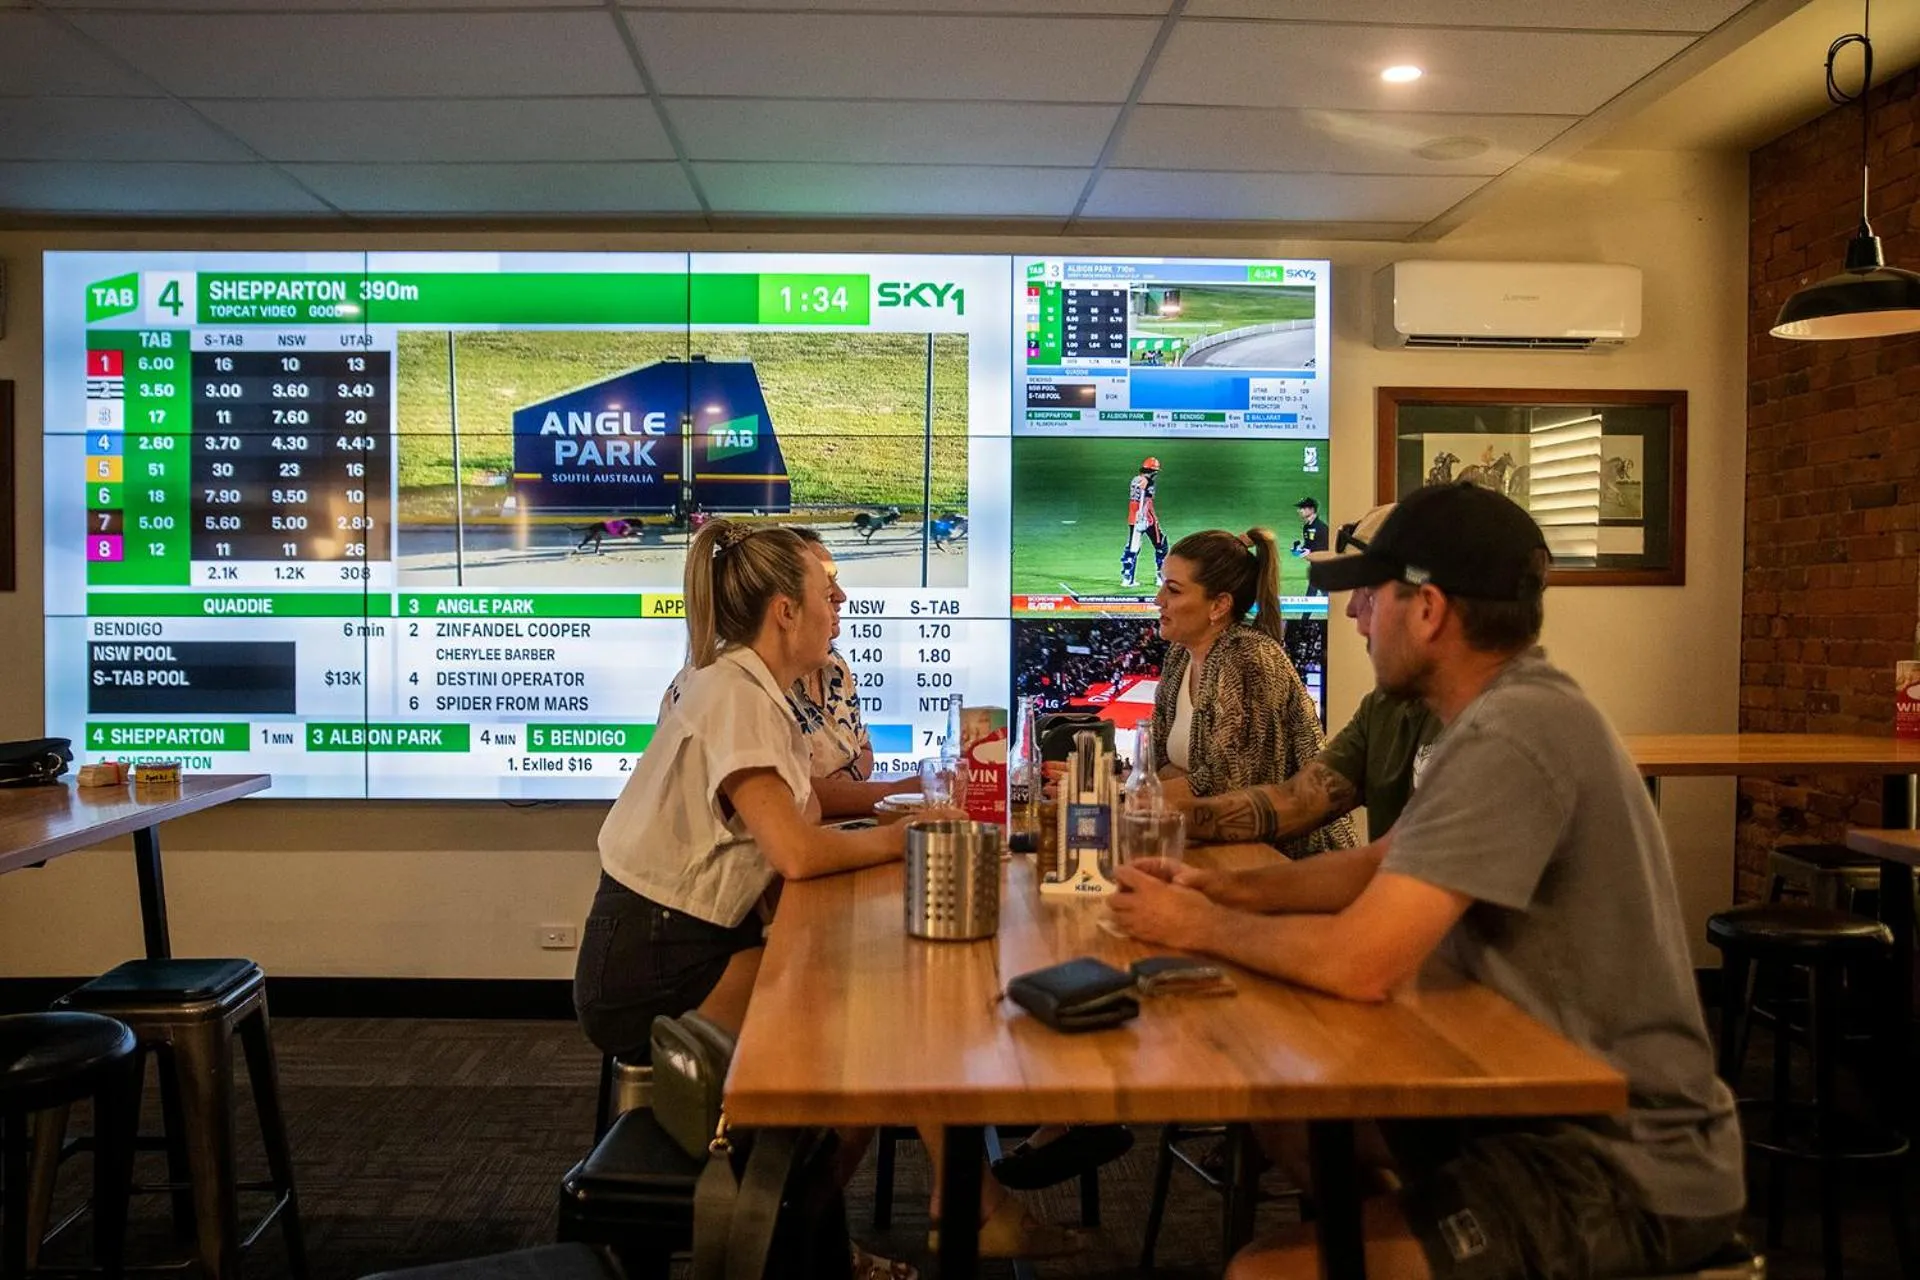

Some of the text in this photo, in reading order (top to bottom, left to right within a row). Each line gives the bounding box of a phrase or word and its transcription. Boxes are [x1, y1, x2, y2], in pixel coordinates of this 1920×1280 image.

[1051, 265, 1060, 277] 3
[92, 288, 133, 307] TAB
[209, 281, 419, 300] SHEPPARTON 390m
[158, 280, 184, 317] 4
[780, 286, 849, 313] 1:34
[210, 305, 257, 318] TOPCAT
[259, 305, 296, 318] VIDEO
[139, 332, 172, 347] TAB
[204, 334, 243, 347] S-TAB
[278, 334, 306, 347] NSW
[340, 334, 373, 347] UTAB
[101, 357, 109, 371] 1
[138, 357, 174, 371] 6.00
[214, 357, 233, 371] 16
[281, 357, 300, 371] 10
[347, 357, 365, 371] 13
[139, 384, 175, 398] 3.50
[205, 384, 242, 398] 3.00
[272, 384, 309, 398] 3.60
[338, 384, 374, 398] 3.40
[149, 410, 166, 424] 17
[216, 410, 232, 424] 11
[272, 410, 309, 424] 7.60
[345, 410, 367, 424] 20
[540, 411, 666, 436] ANGLE
[98, 436, 110, 450] 4
[138, 436, 174, 450] 2.60
[205, 436, 241, 450] 3.70
[272, 436, 308, 450] 4.30
[337, 436, 375, 450] 4.40
[711, 430, 754, 448] TAB
[555, 440, 656, 466] PARK
[98, 462, 110, 477] 5
[148, 463, 165, 476] 51
[212, 463, 234, 476] 30
[280, 463, 300, 476] 23
[346, 463, 364, 476] 16
[552, 472, 654, 483] SOUTH AUSTRALIA
[98, 488, 110, 504] 6
[148, 490, 165, 503] 18
[204, 490, 241, 503] 7.90
[272, 490, 308, 503] 9.50
[346, 490, 364, 503] 10
[99, 514, 110, 530] 7
[138, 516, 174, 530] 5.00
[205, 516, 241, 530] 5.60
[272, 516, 308, 530] 5.00
[338, 516, 374, 530] 2.80
[98, 542, 111, 557] 8
[148, 543, 165, 556] 12
[216, 543, 231, 556] 11
[282, 543, 298, 556] 11
[345, 543, 365, 556] 26
[208, 567, 238, 580] 2.1K
[274, 567, 305, 580] 1.2K
[203, 599, 273, 615] QUADDIE
[408, 600, 534, 614] 3 ANGLE PARK
[654, 601, 684, 614] APP
[850, 600, 885, 614] NSW
[910, 600, 960, 614] S-TAB
[94, 622, 162, 636] BENDIGO
[343, 622, 385, 636] 6 min
[409, 624, 591, 638] 2 ZINFANDEL COOPER
[850, 624, 882, 638] 1.50
[918, 624, 950, 638] 1.70
[93, 646, 176, 661] NSW POOL
[436, 648, 555, 661] CHERYLEE BARBER
[850, 648, 883, 662] 1.40
[918, 648, 951, 662] 1.80
[93, 670, 190, 686] S-TAB POOL
[324, 671, 362, 686] $13K
[409, 672, 584, 686] 4 DESTINI OPERATOR
[917, 673, 952, 687] 5.00
[409, 696, 589, 710] 6 SPIDER FROM MARS
[860, 698, 882, 712] TD
[919, 698, 950, 712] NTD
[1045, 699, 1059, 708] LG
[93, 729, 626, 746] 4 SHEPPARTON 1 MIN 3 ALBION PARK 4 MIN 5 BENDIGO
[923, 731, 934, 746] 7
[508, 759, 518, 772] 1.
[568, 758, 592, 773] $16
[892, 758, 920, 774] Spa
